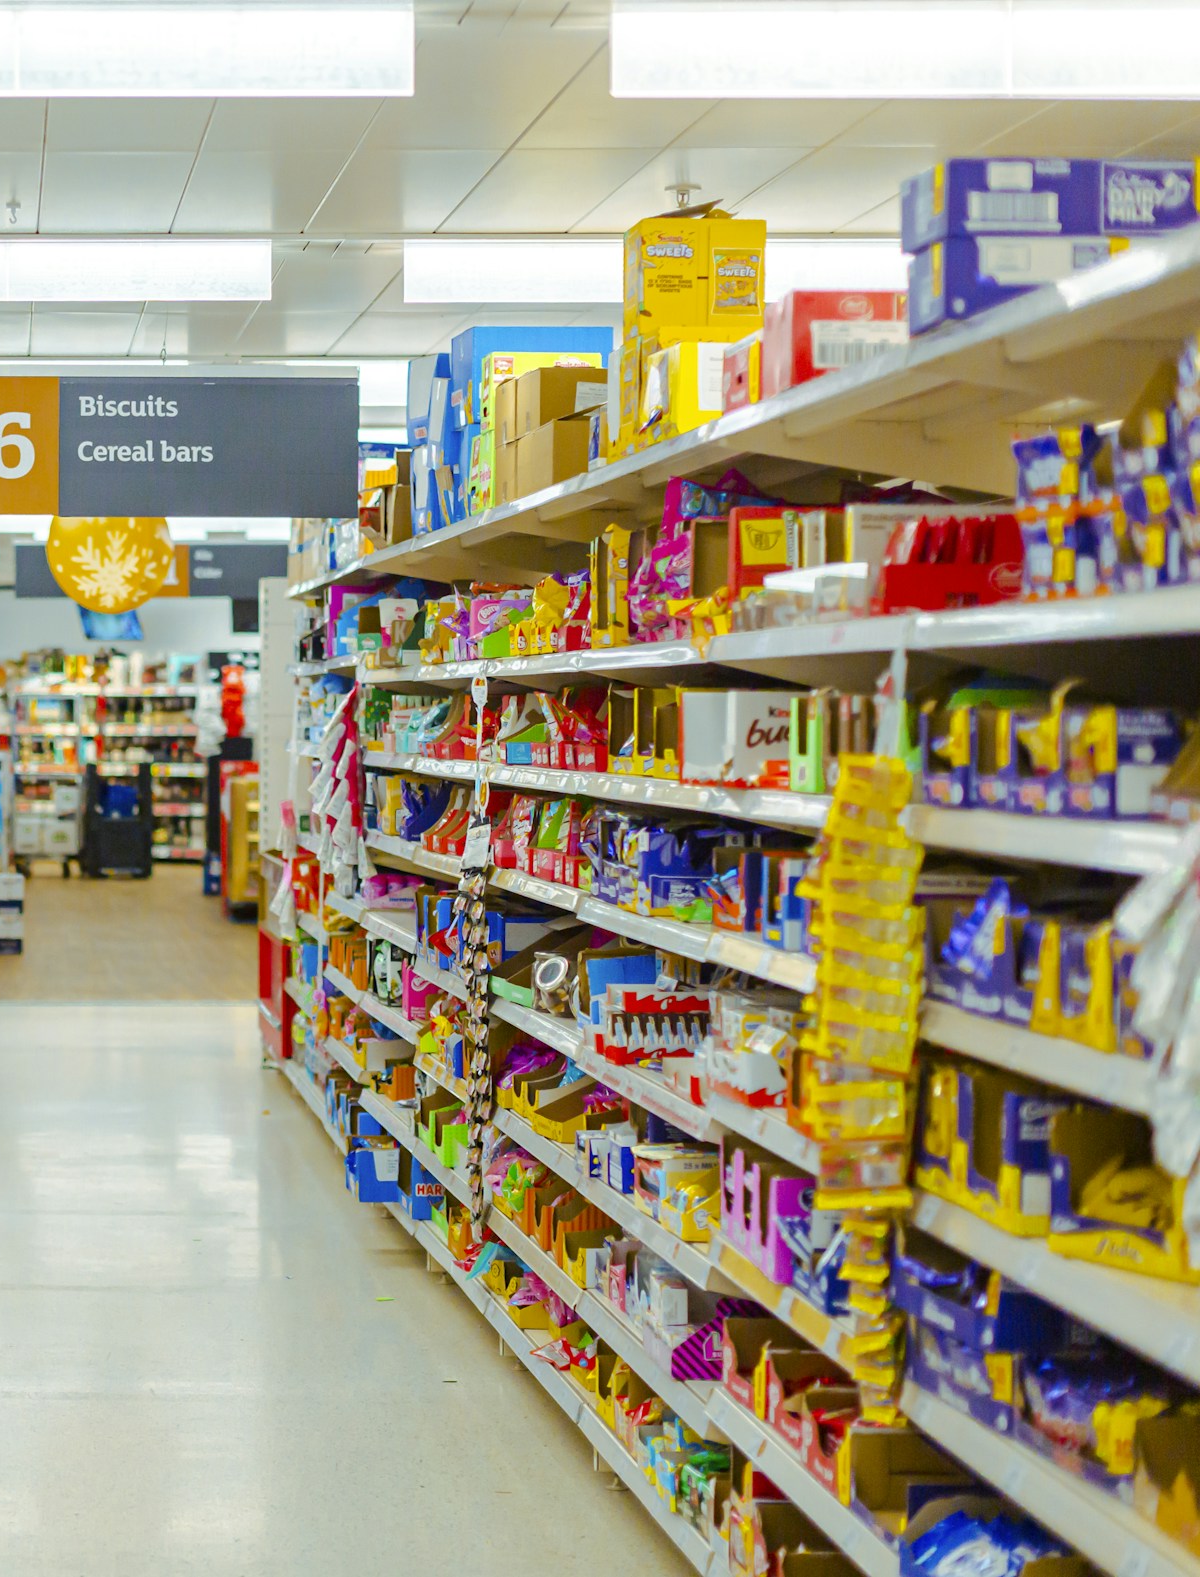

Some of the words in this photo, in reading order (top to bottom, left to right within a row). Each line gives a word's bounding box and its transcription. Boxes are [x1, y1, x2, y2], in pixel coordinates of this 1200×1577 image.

[646, 244, 693, 258] SWEETS
[717, 265, 756, 277] SWEETS
[78, 395, 179, 417] Biscuits
[77, 440, 155, 462] Cereal
[160, 440, 214, 463] bars
[415, 1183, 443, 1197] HAR
